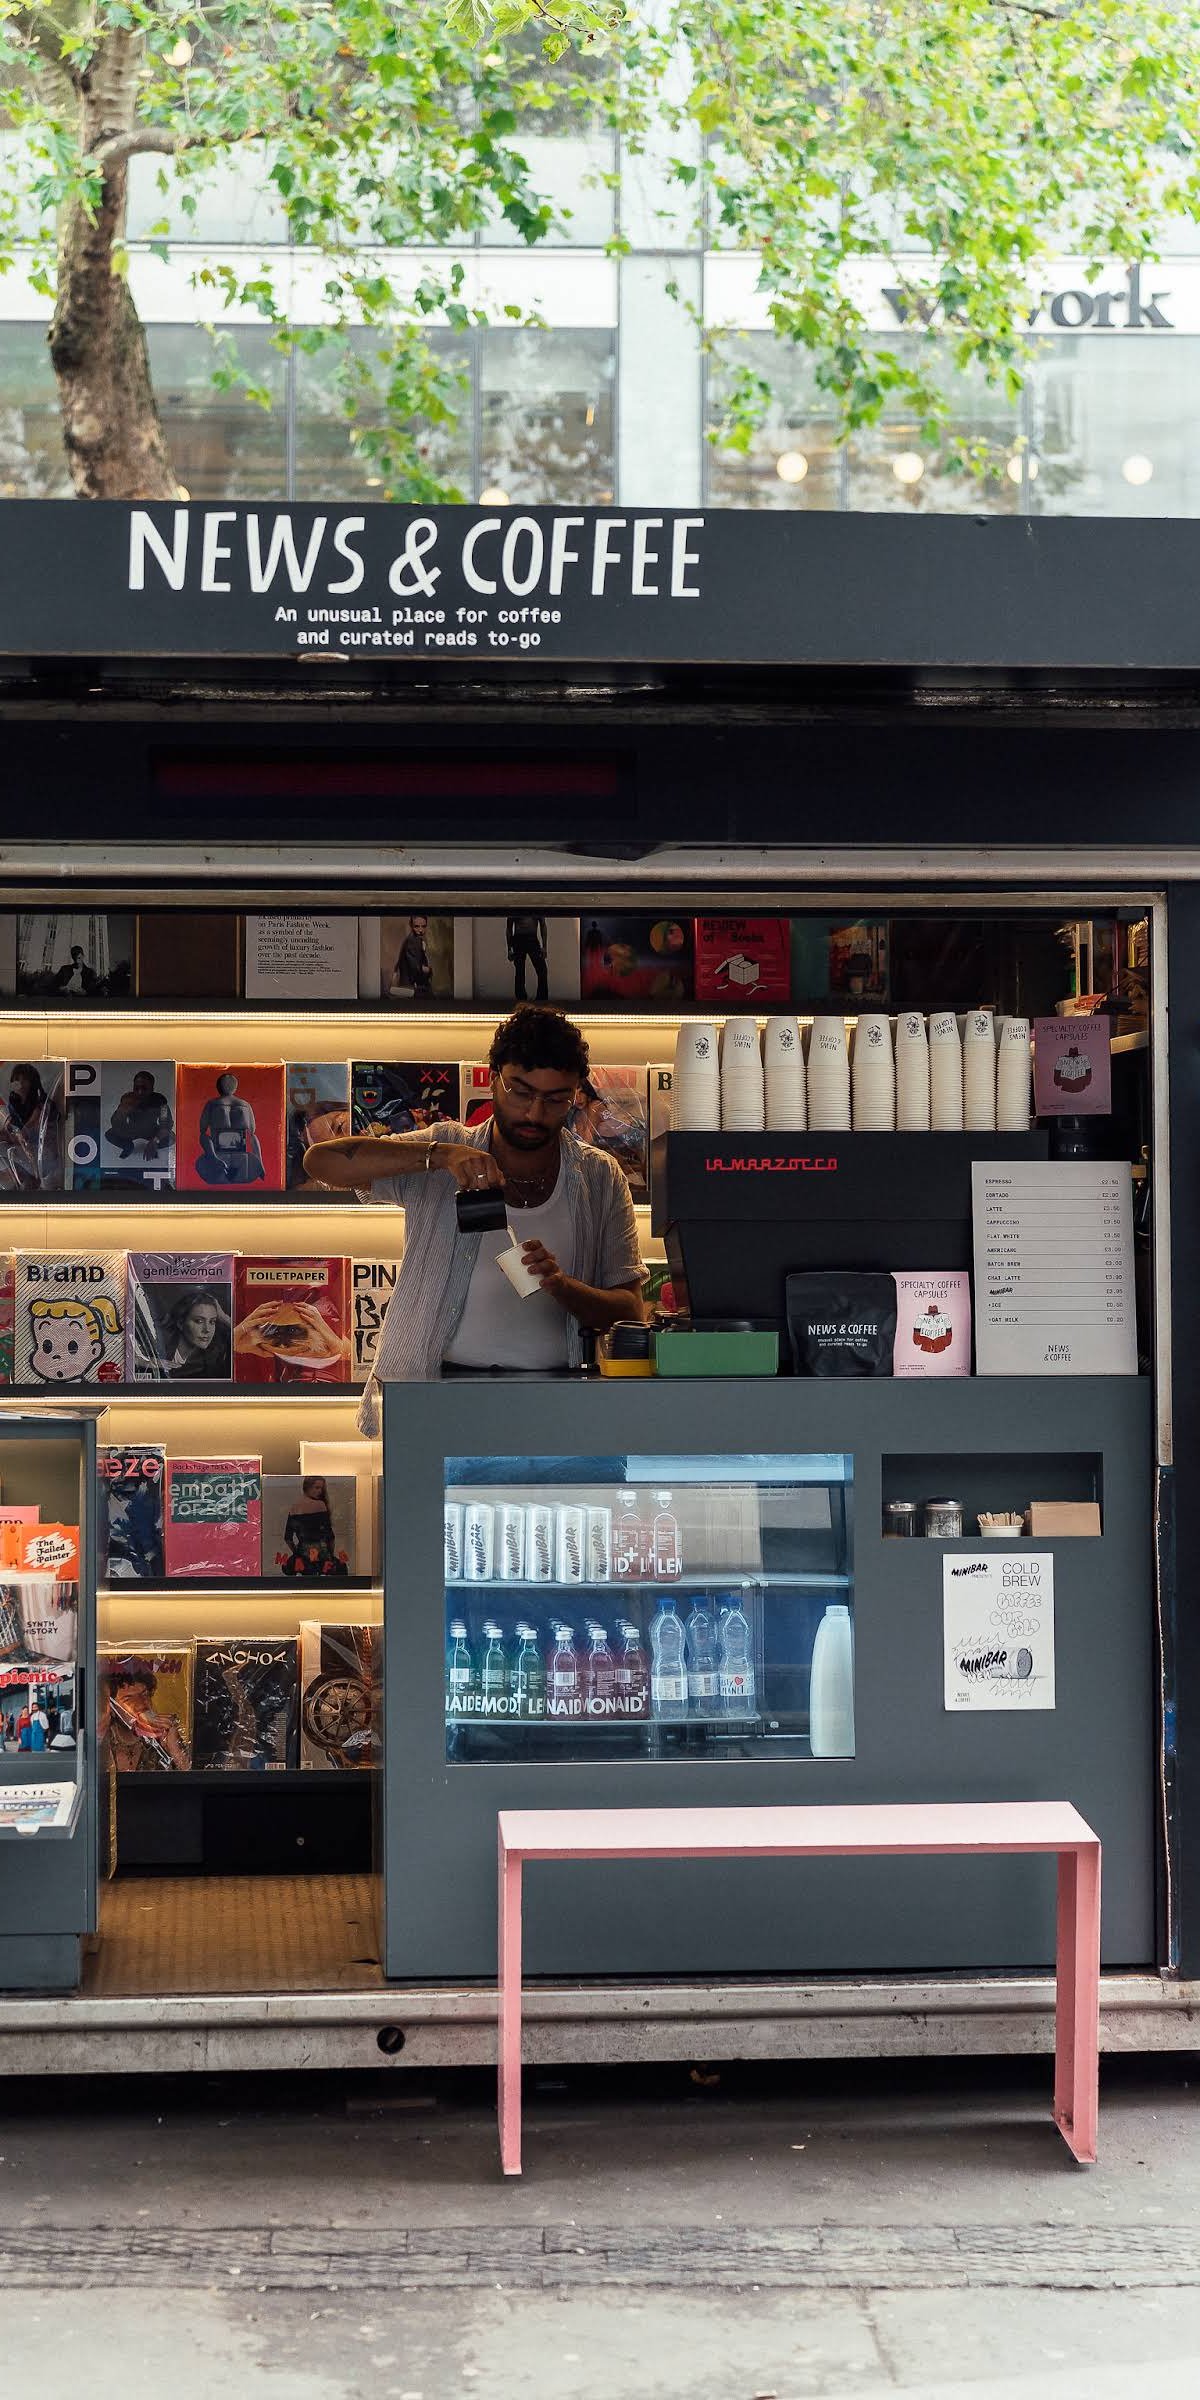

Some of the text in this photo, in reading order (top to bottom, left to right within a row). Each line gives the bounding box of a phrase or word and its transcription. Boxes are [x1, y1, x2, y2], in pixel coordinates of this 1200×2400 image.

[129, 509, 705, 598] NEWS & COFFEE
[275, 606, 562, 627] An unusual place for coffee
[297, 629, 541, 650] and curated reads to-go
[272, 929, 294, 937] symbol
[290, 944, 310, 952] luxury
[1042, 1023, 1102, 1032] SPECIALTY COFFEE
[1055, 1033, 1088, 1041] CAPSULES
[142, 1264, 223, 1280] gentlewoman
[249, 1271, 326, 1281] TOILETPAPER
[900, 1280, 961, 1290] SPECIALTY COFFEE
[913, 1290, 948, 1299] CAPSULES
[808, 1324, 878, 1336] NEWS & COFFEE
[1048, 1344, 1070, 1353] NEWS
[168, 1479, 261, 1501] empathy
[36, 1540, 54, 1548] The
[36, 1543, 65, 1557] Failed
[475, 1523, 487, 1574] MINIBAR
[506, 1523, 521, 1574] MINIBAR
[534, 1524, 551, 1575] MINIBAR
[591, 1525, 608, 1575] MINIBAR
[36, 1552, 70, 1563] Painter
[565, 1527, 581, 1577] MINIBAR
[951, 1563, 989, 1577] MINIBAR
[1002, 1562, 1040, 1575] COLD
[1002, 1575, 1042, 1587] BREW
[996, 1591, 1042, 1610] COFFEE
[206, 1650, 287, 1666] ANCHOA
[960, 1649, 1008, 1673] MINIBAR
